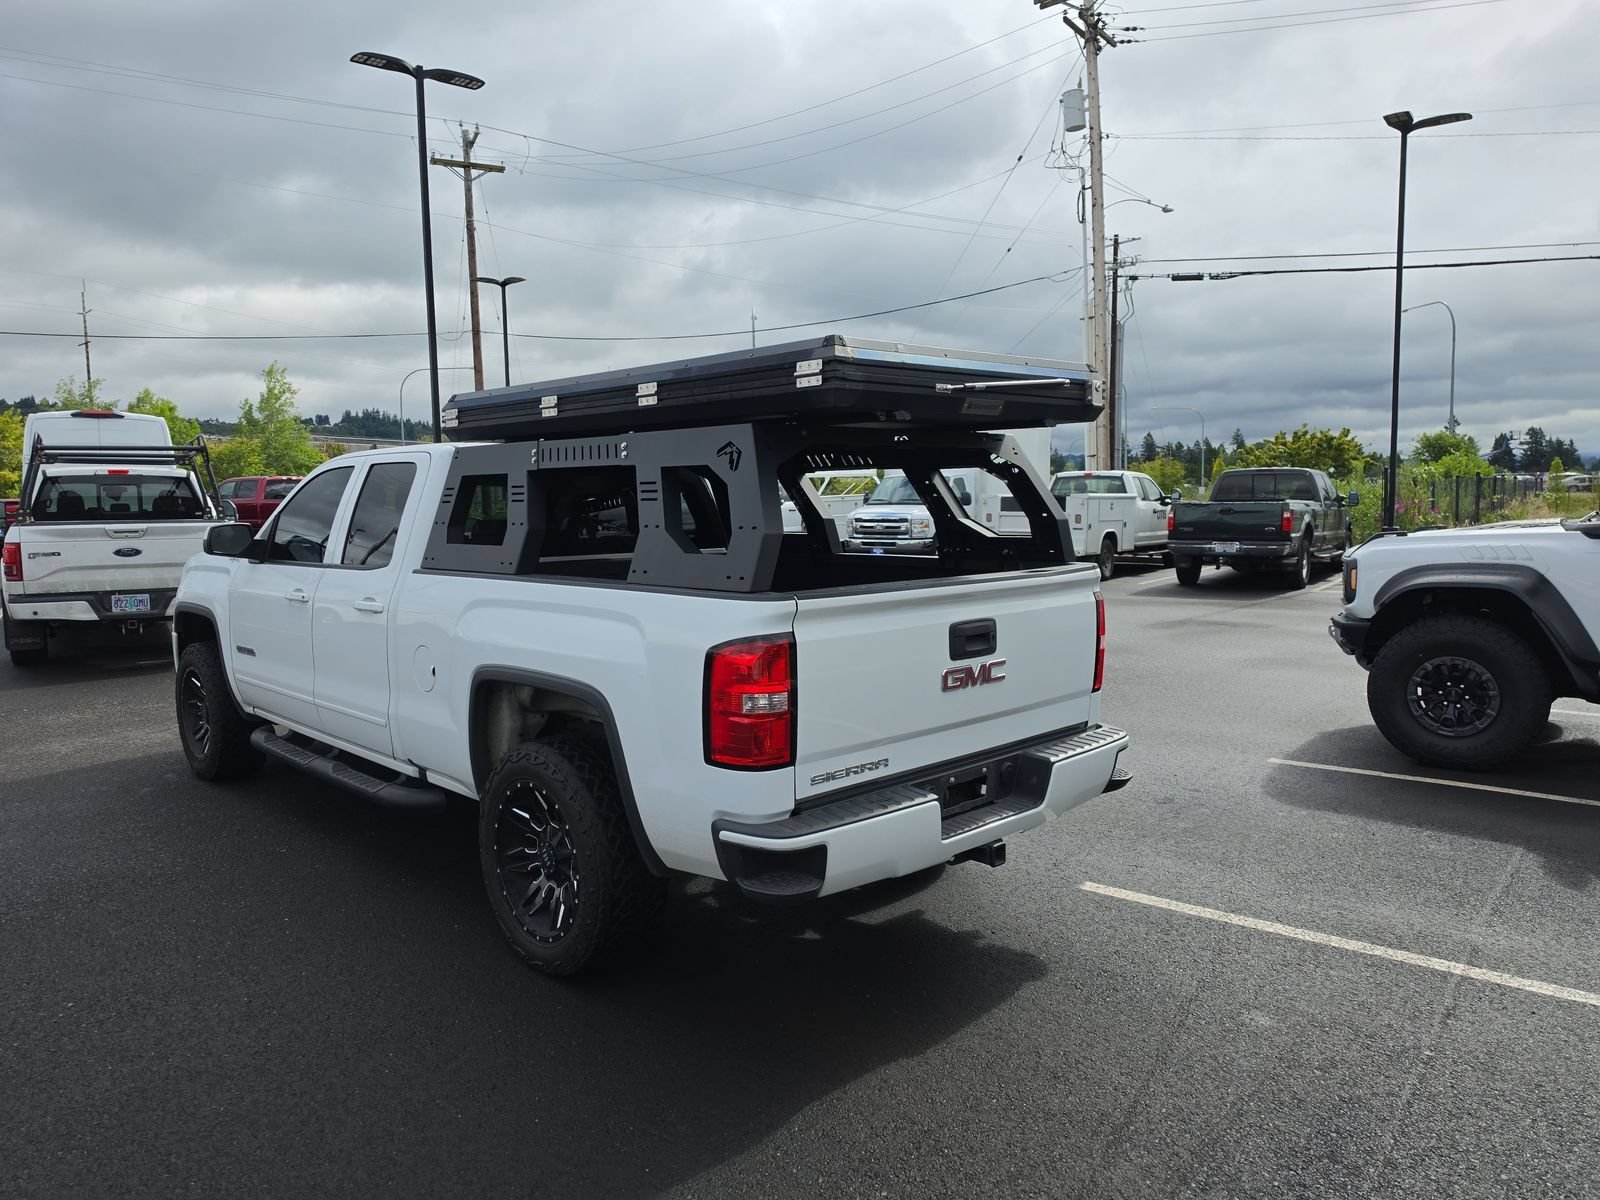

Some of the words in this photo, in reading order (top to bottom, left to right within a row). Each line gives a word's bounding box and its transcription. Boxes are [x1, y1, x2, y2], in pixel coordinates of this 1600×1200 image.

[113, 598, 129, 609] 822
[942, 658, 1007, 691] GMC
[810, 757, 889, 786] SIERRA
